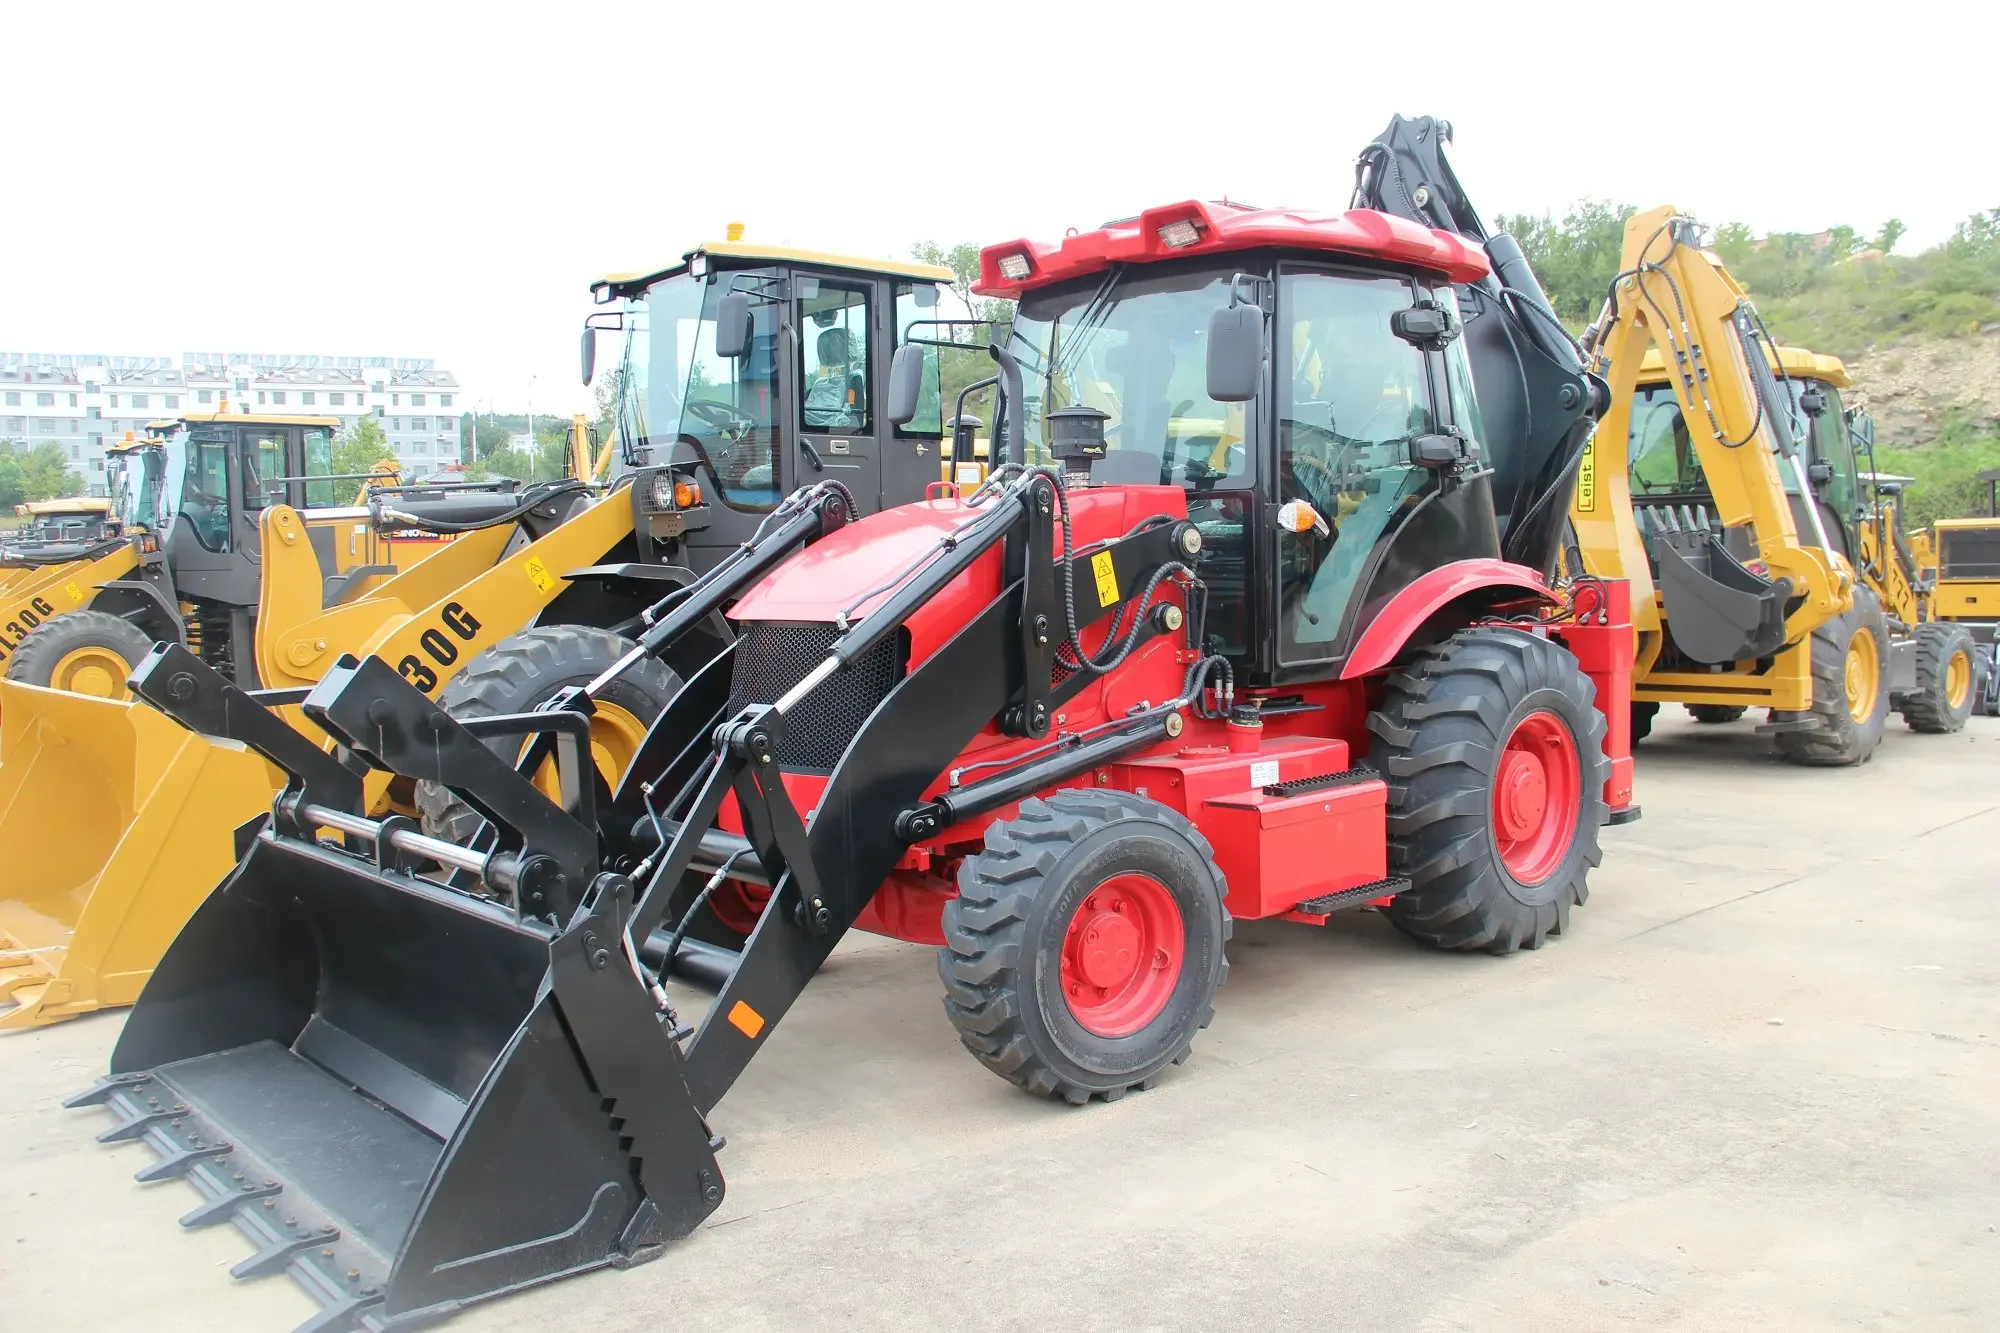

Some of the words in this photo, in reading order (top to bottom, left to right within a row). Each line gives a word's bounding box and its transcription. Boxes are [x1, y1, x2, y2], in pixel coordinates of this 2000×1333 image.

[1580, 464, 1592, 508] Leist
[0, 597, 55, 661] L30G
[398, 602, 482, 693] 30G
